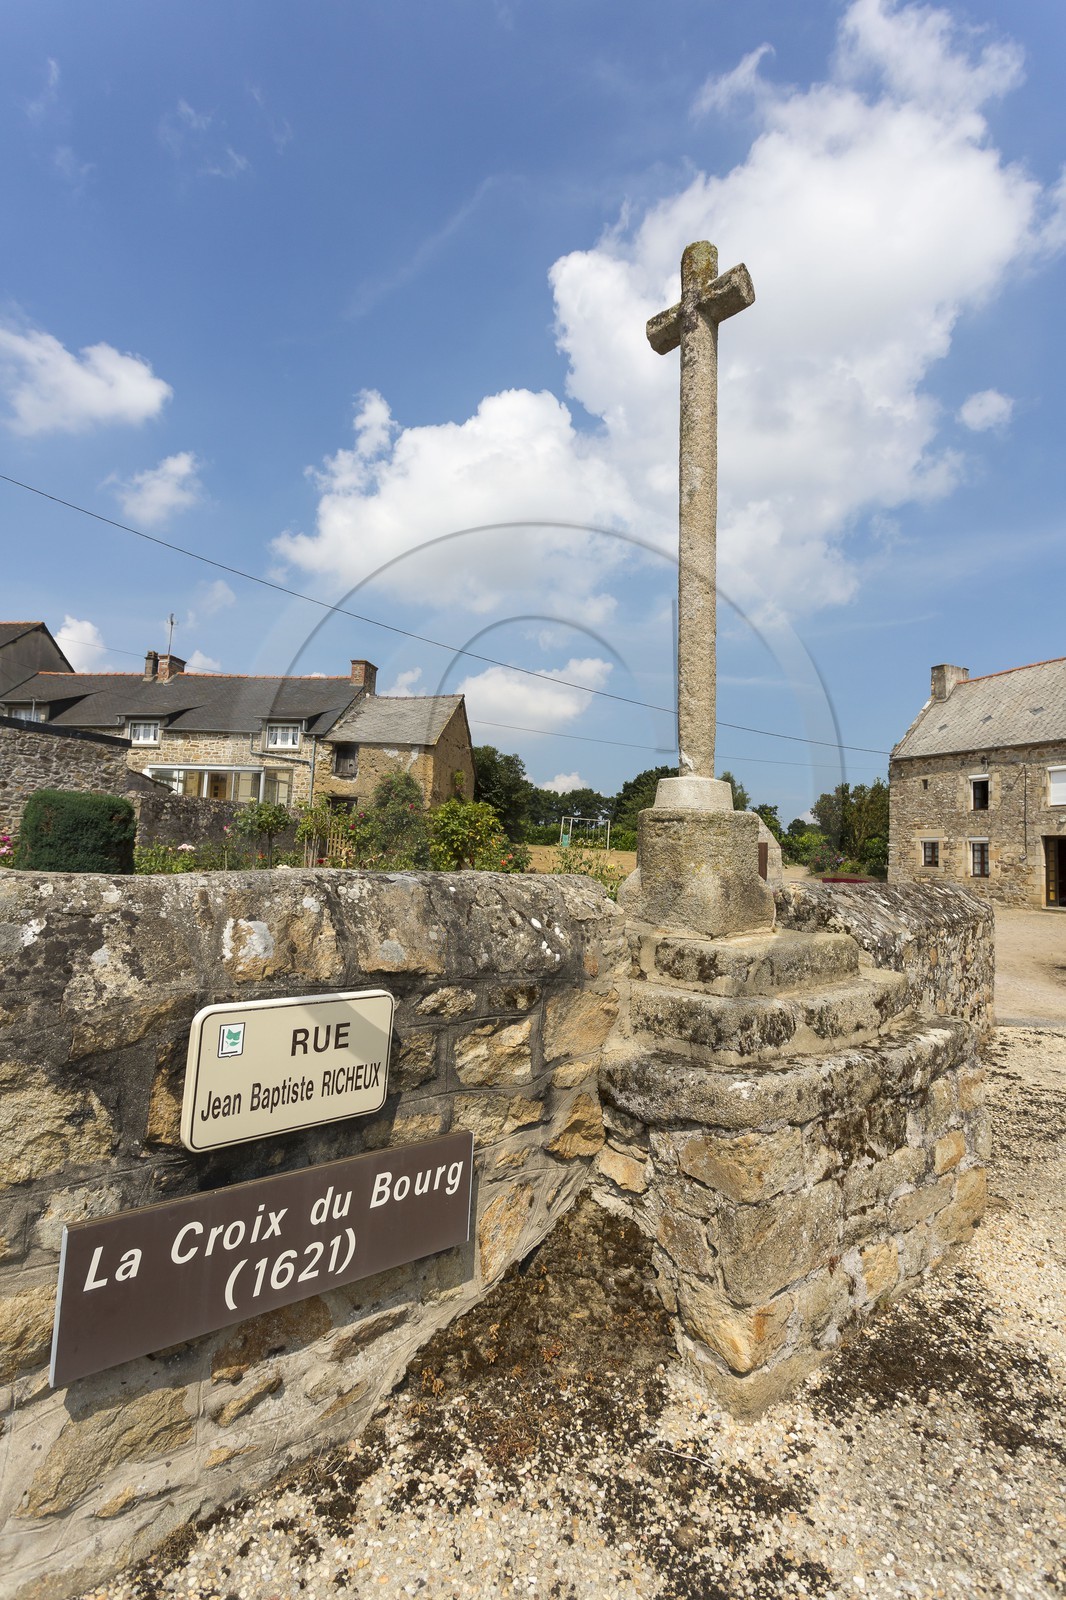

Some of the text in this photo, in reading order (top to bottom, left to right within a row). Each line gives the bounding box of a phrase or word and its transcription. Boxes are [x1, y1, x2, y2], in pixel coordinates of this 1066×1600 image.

[290, 1022, 351, 1057] RUE
[201, 1062, 381, 1122] Jean Baptiste RICHEUX
[82, 1159, 464, 1292] La Croix du Bourg
[224, 1227, 357, 1310] (1621)
